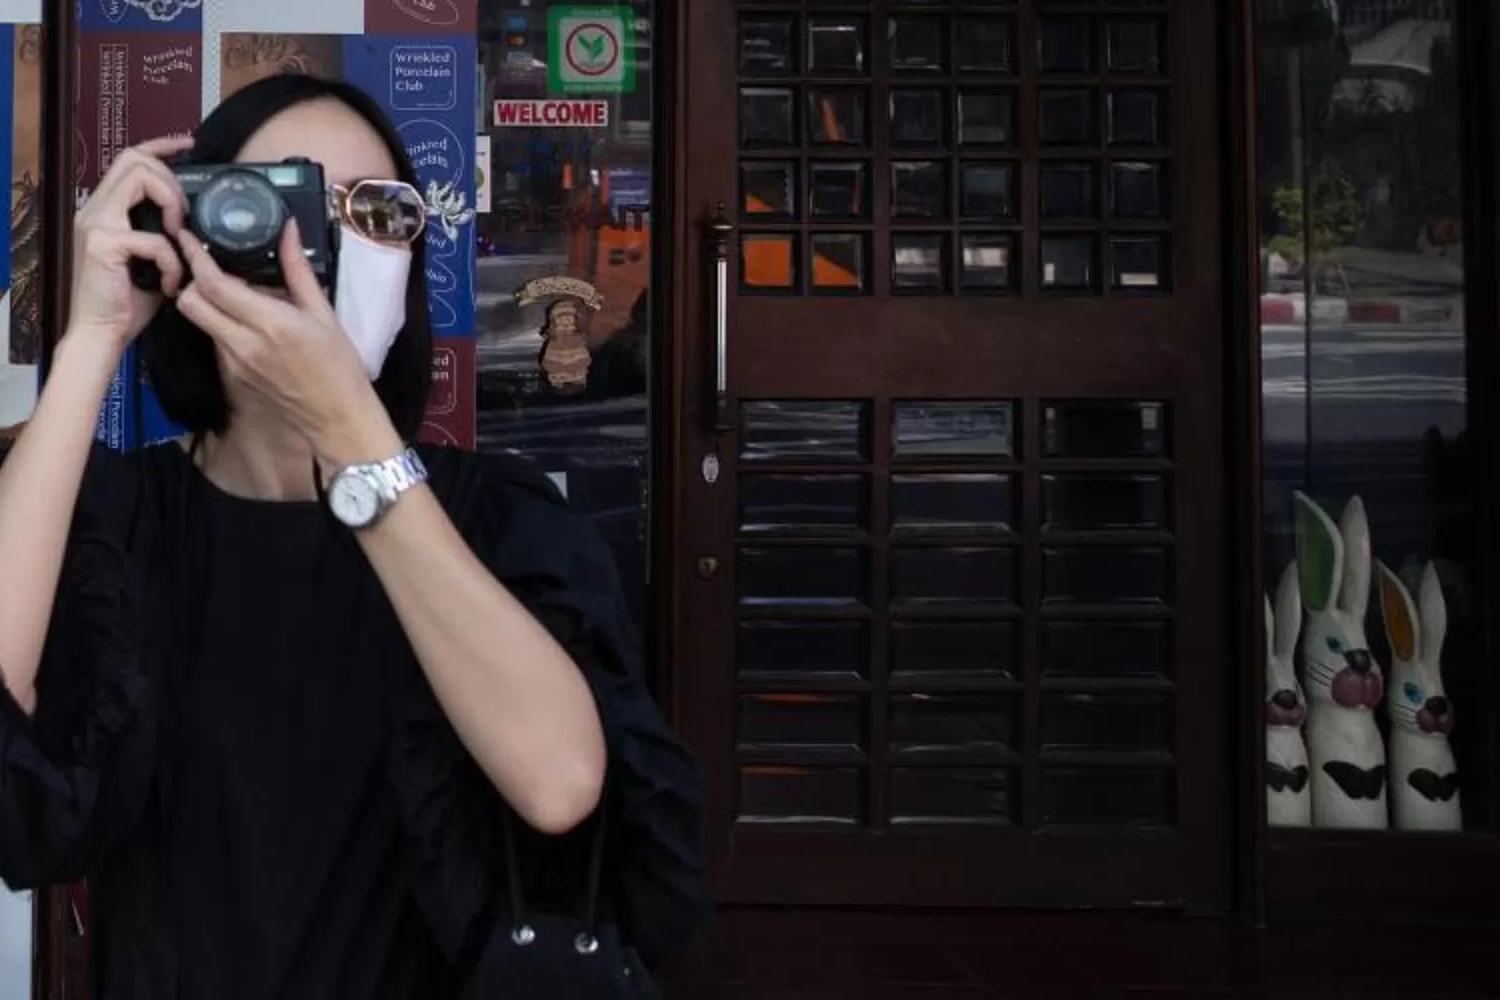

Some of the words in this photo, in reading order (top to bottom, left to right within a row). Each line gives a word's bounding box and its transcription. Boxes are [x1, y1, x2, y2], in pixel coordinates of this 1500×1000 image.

[395, 51, 452, 64] Wrinkled
[395, 65, 452, 78] Porcelain
[395, 79, 424, 92] Club
[497, 103, 606, 124] WELCOME
